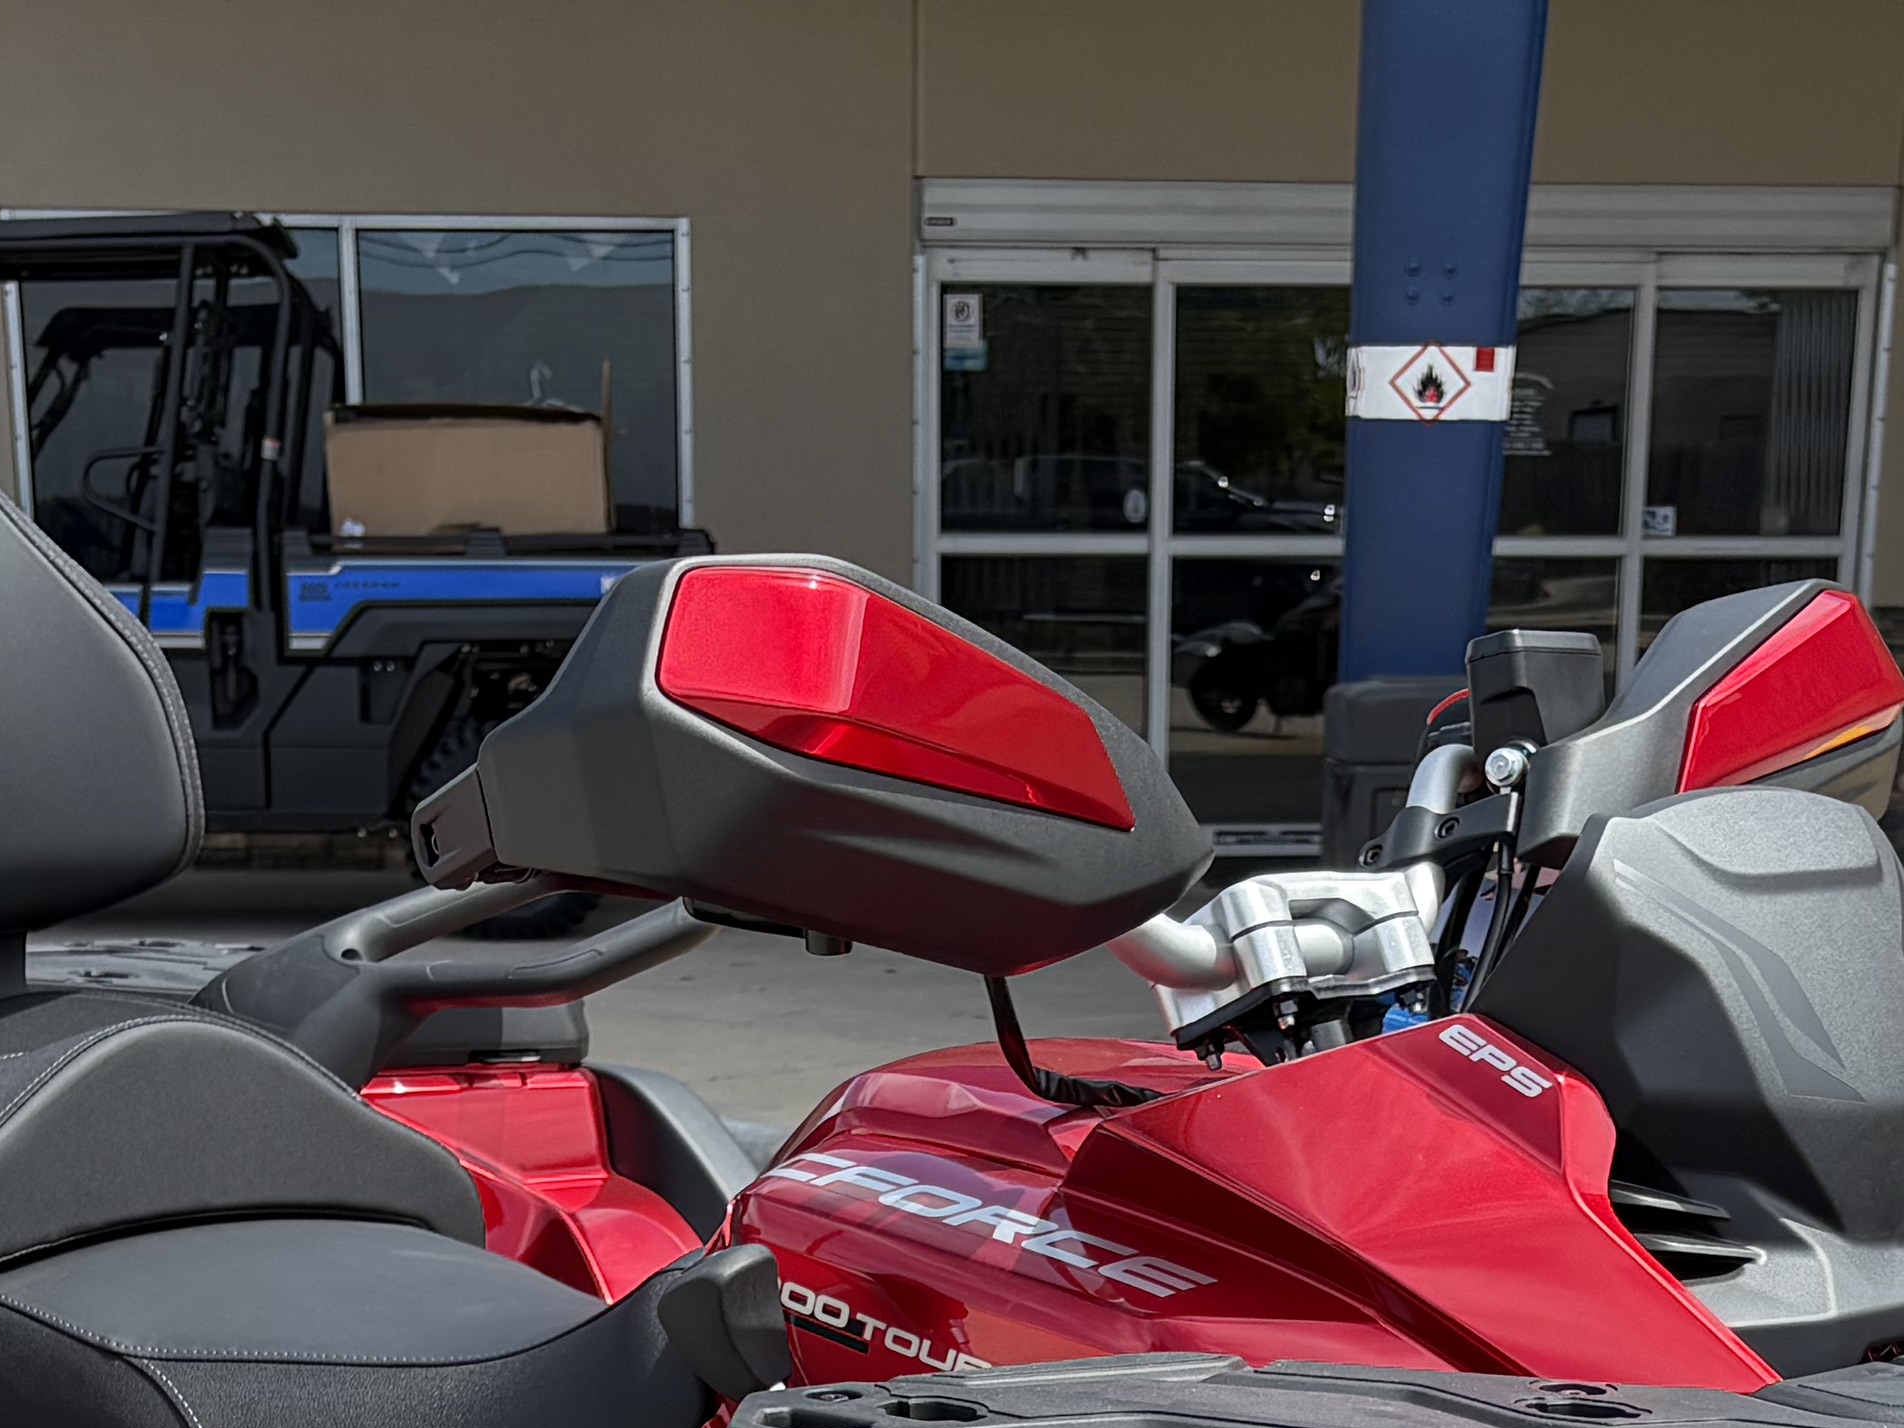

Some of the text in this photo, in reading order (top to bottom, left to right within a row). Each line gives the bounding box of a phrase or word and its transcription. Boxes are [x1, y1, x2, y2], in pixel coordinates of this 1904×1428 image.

[1438, 1024, 1552, 1098] EPS
[760, 1152, 1218, 1298] CFORCE
[778, 1277, 850, 1329] 00
